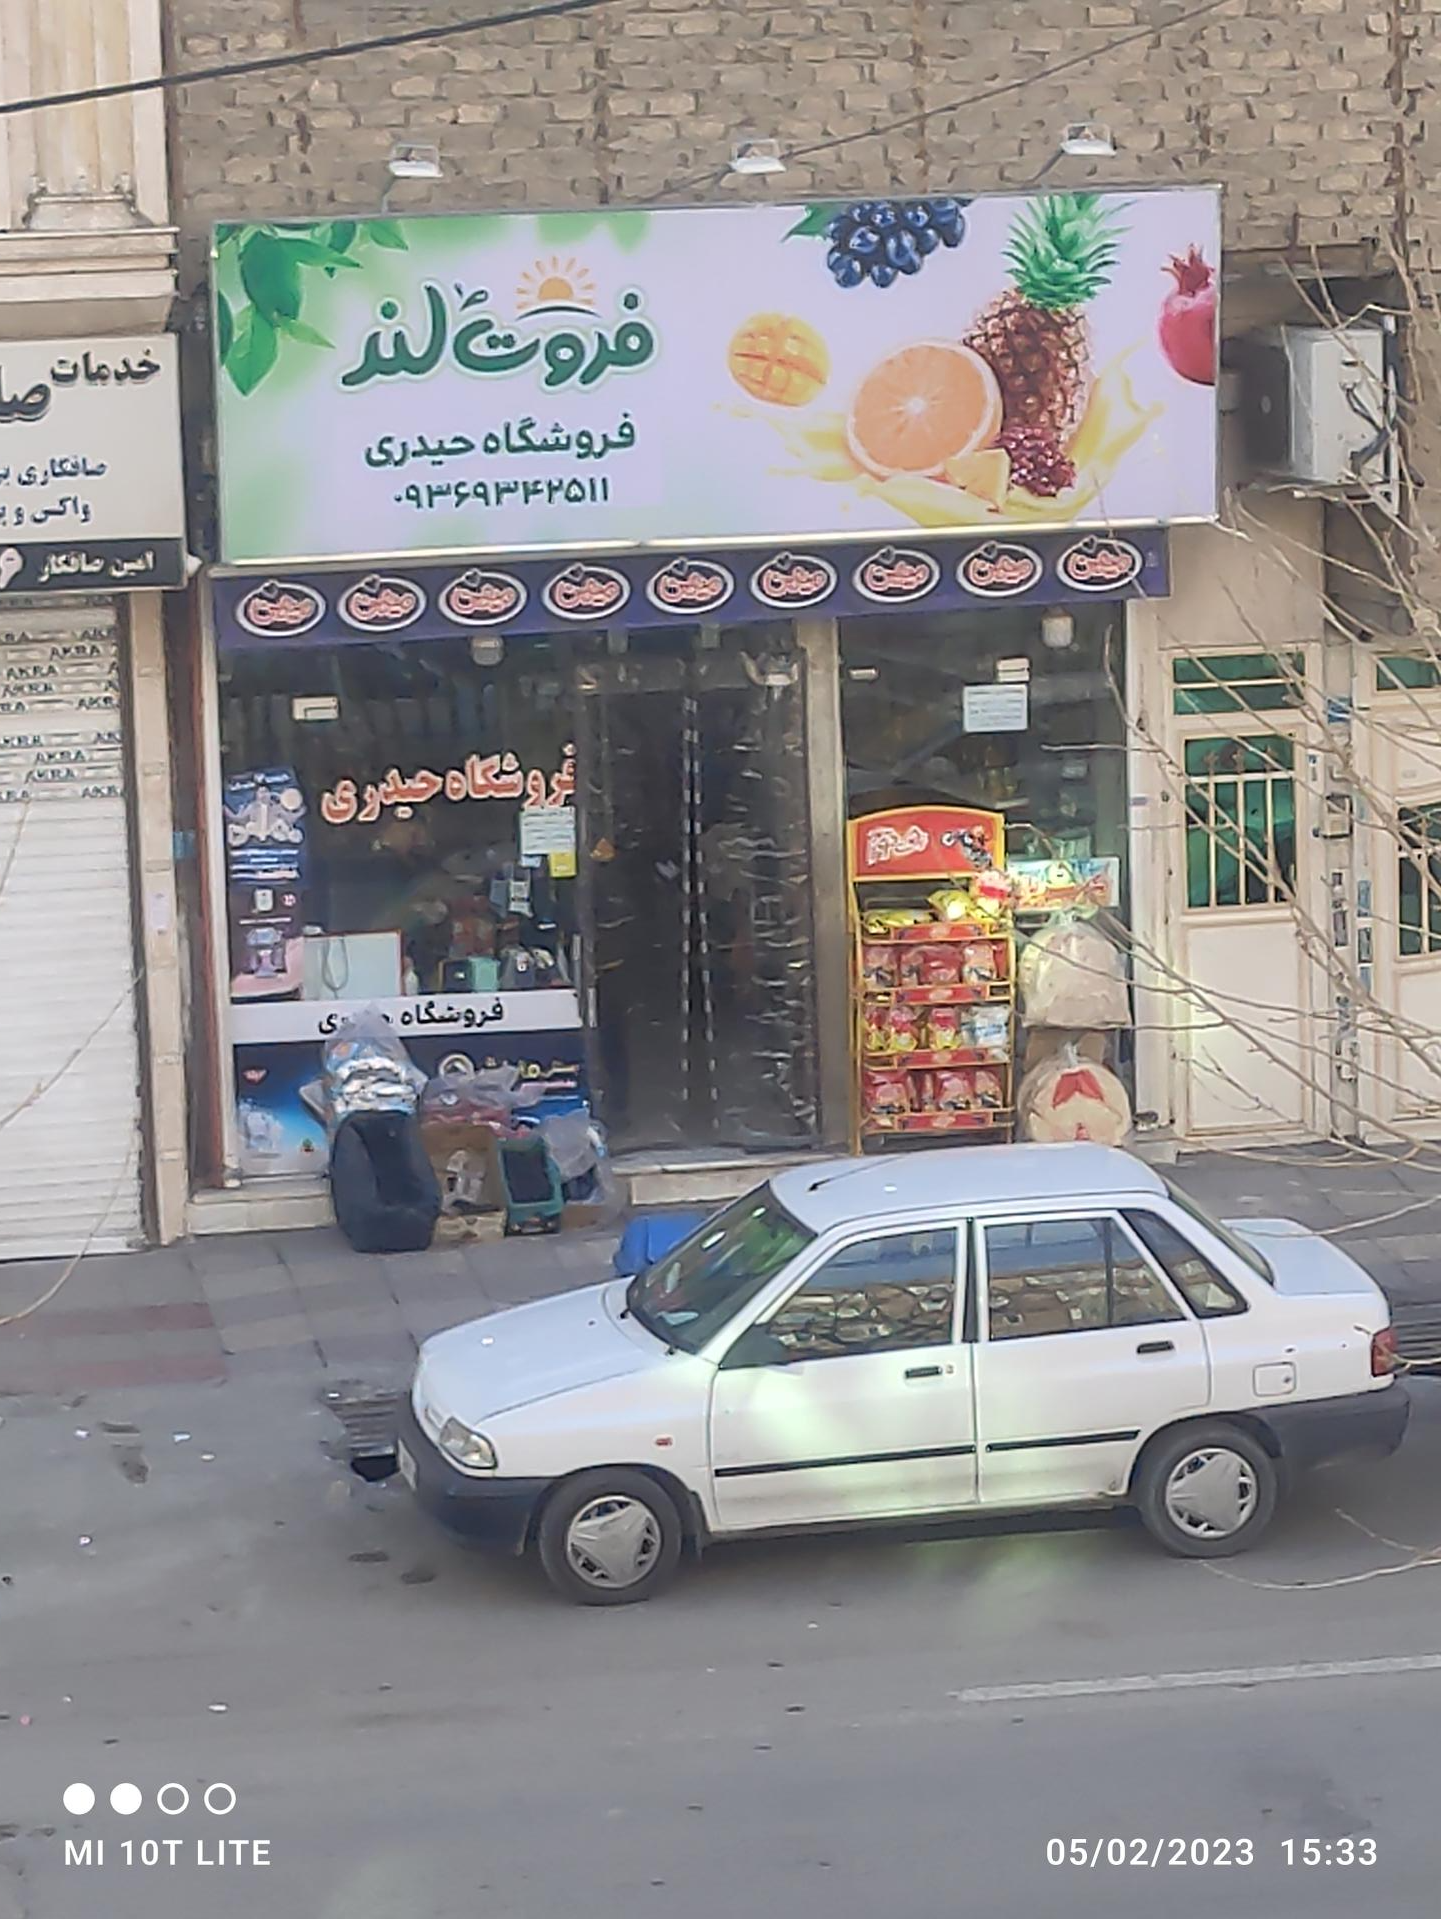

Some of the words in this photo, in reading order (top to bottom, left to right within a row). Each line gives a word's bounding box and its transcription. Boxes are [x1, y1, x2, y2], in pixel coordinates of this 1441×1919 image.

[341, 284, 447, 387] لند
[453, 291, 654, 387] فروت
[50, 349, 161, 383] خدمات
[364, 434, 475, 467] حیدری
[483, 412, 636, 459] فروشگاه
[17, 455, 107, 486] صافکاری
[13, 506, 25, 526] و
[109, 550, 155, 578] امین
[321, 768, 443, 824] حیدری
[401, 997, 504, 1028] فروشگاه
